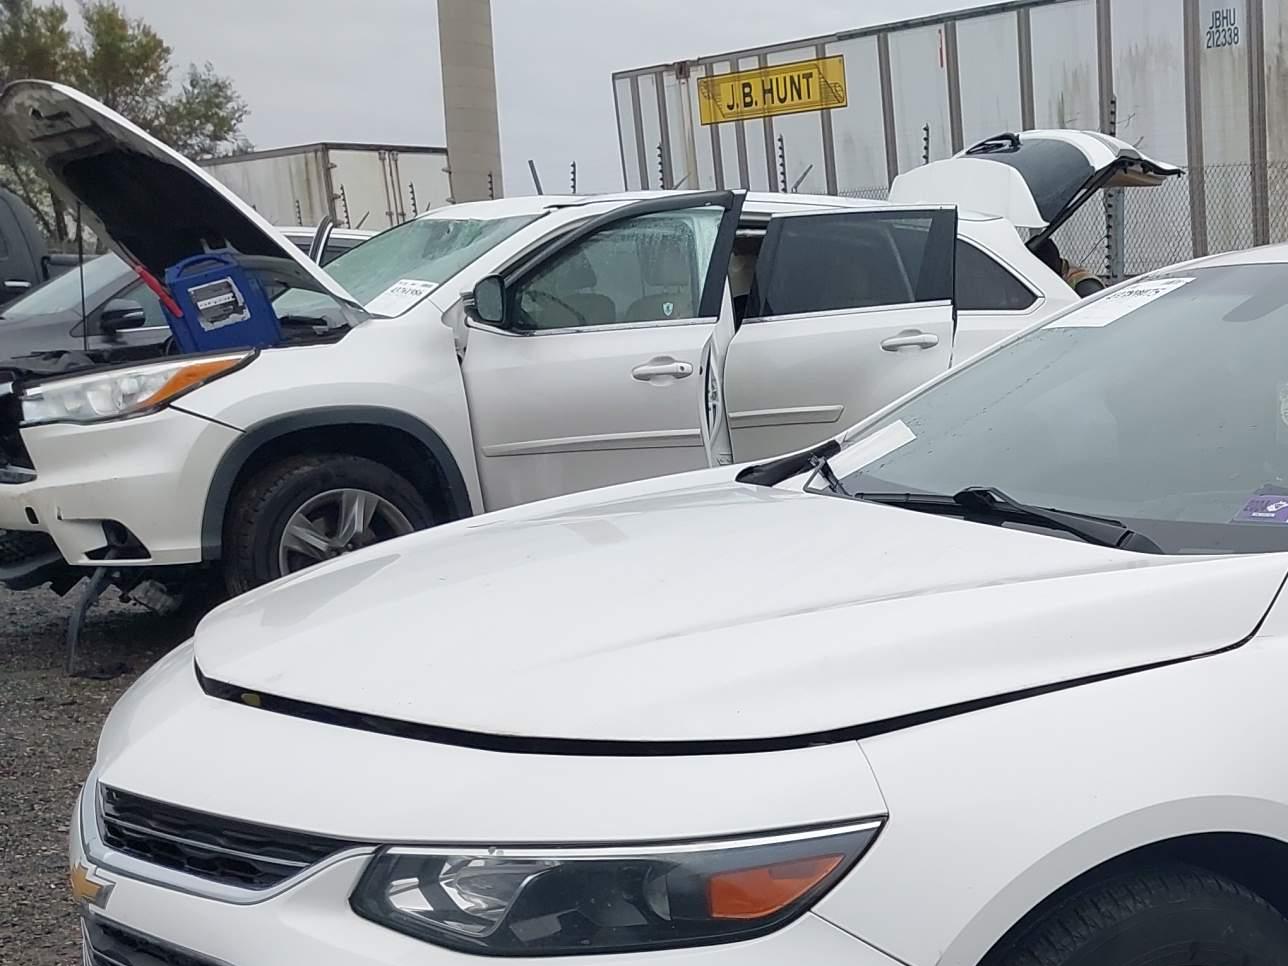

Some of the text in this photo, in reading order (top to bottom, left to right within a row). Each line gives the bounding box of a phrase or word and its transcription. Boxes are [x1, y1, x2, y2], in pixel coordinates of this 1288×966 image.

[1208, 7, 1236, 30] JBHU
[1206, 26, 1240, 49] 212338
[761, 71, 813, 106] HUNT
